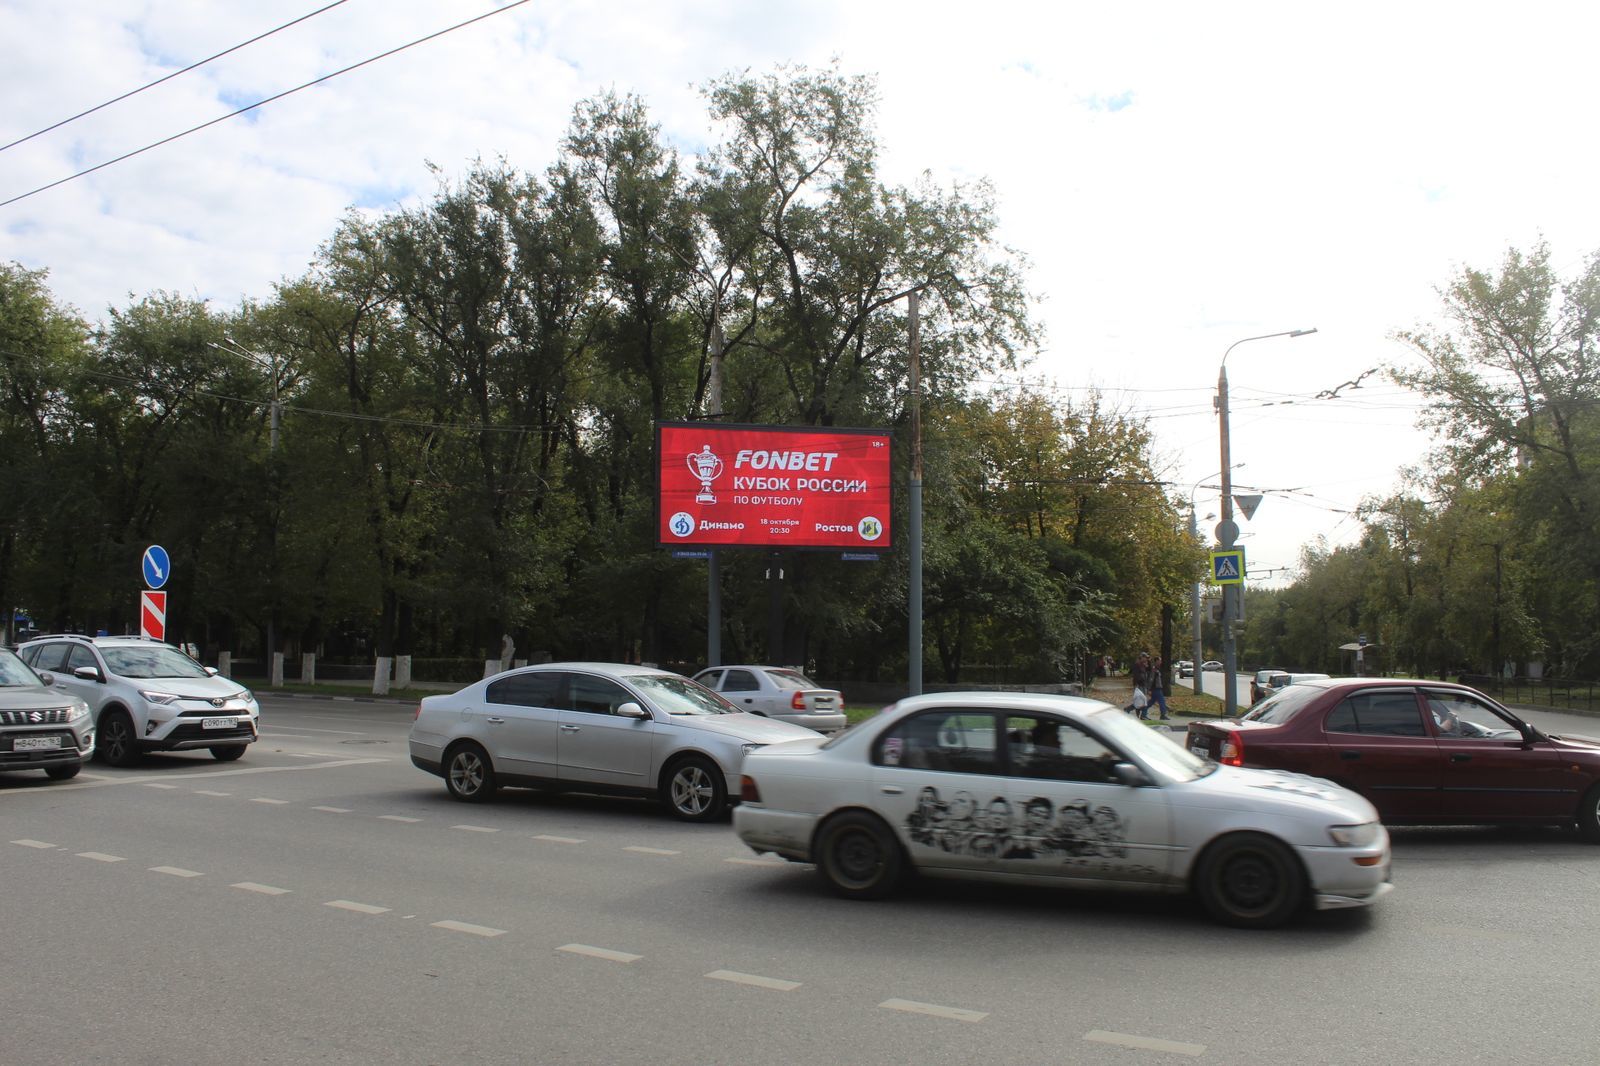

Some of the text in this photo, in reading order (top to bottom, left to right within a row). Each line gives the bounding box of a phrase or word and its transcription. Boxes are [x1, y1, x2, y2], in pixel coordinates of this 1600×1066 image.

[734, 449, 838, 472] FONBET
[733, 476, 867, 493] КУБОК РОССИИ
[733, 495, 803, 506] ПО ФУТБОЛУ
[699, 519, 745, 531] Динамо
[815, 523, 854, 533] Ростов
